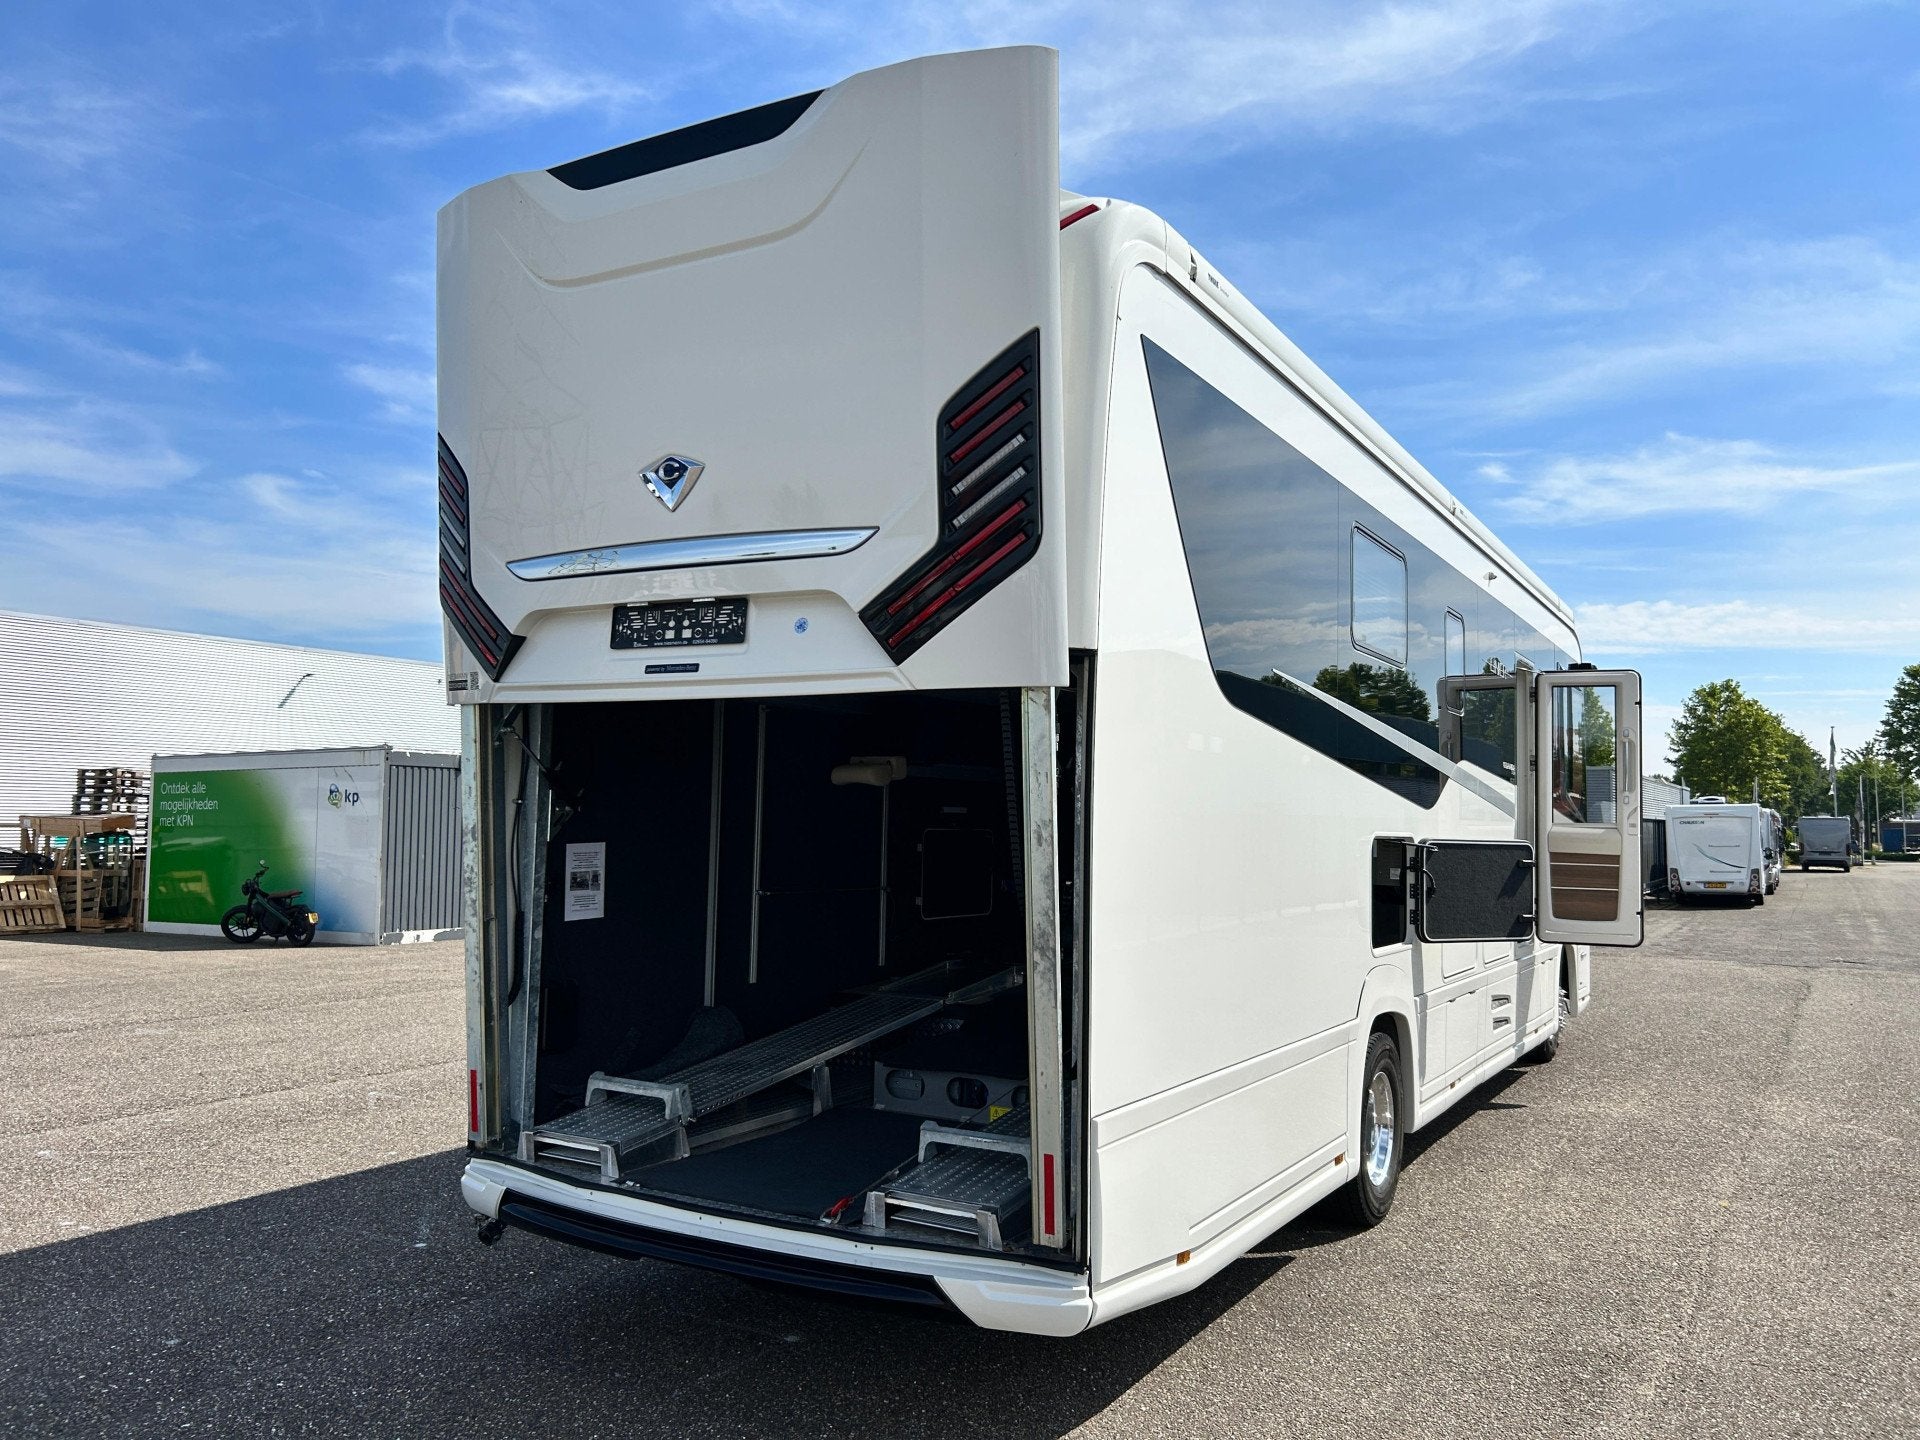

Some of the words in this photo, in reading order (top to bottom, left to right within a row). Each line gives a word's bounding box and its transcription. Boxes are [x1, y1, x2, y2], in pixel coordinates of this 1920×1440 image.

[160, 781, 190, 794] Ontdek
[191, 781, 207, 794] alle
[160, 797, 218, 813] mogelijkheden
[159, 815, 175, 827] met
[176, 814, 194, 827] KPN
